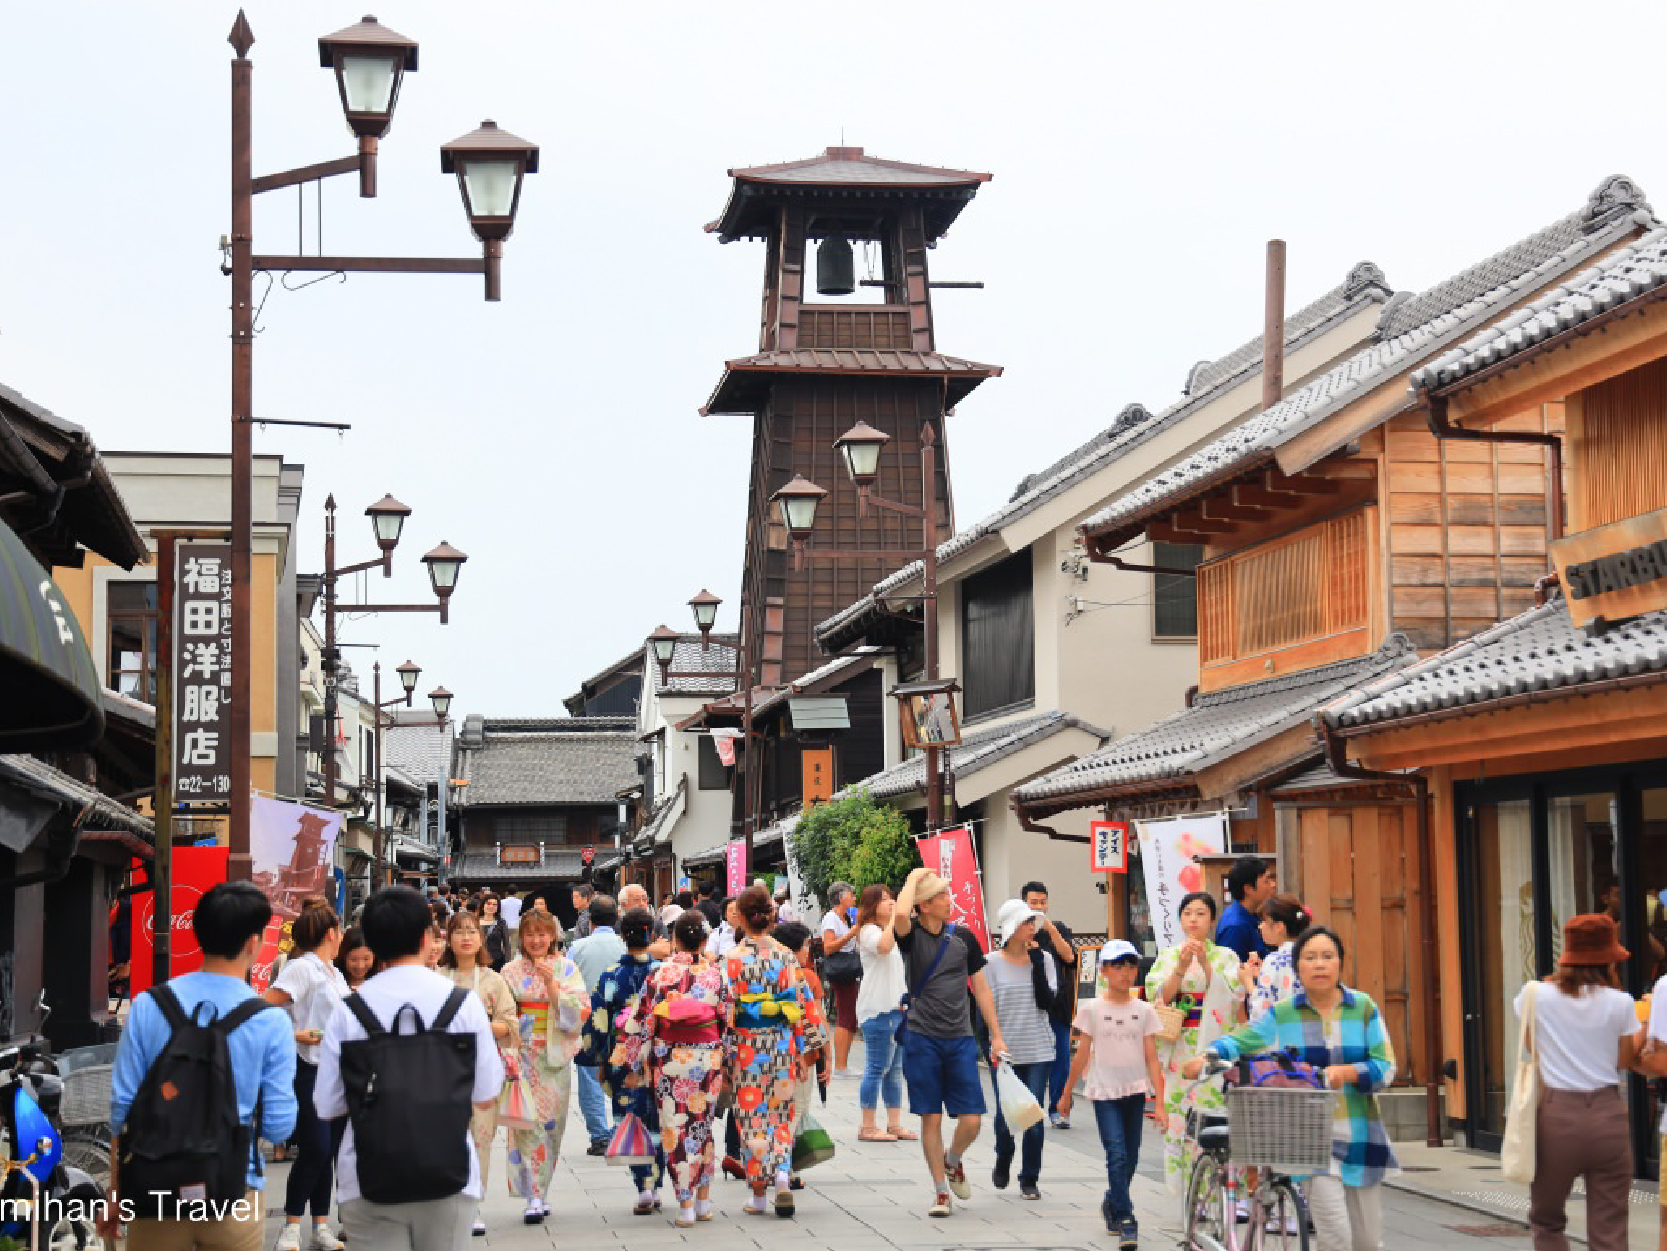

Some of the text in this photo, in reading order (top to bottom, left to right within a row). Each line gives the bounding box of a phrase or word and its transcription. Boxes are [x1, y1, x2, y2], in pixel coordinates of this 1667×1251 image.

[183, 557, 220, 765] 福田洋服店
